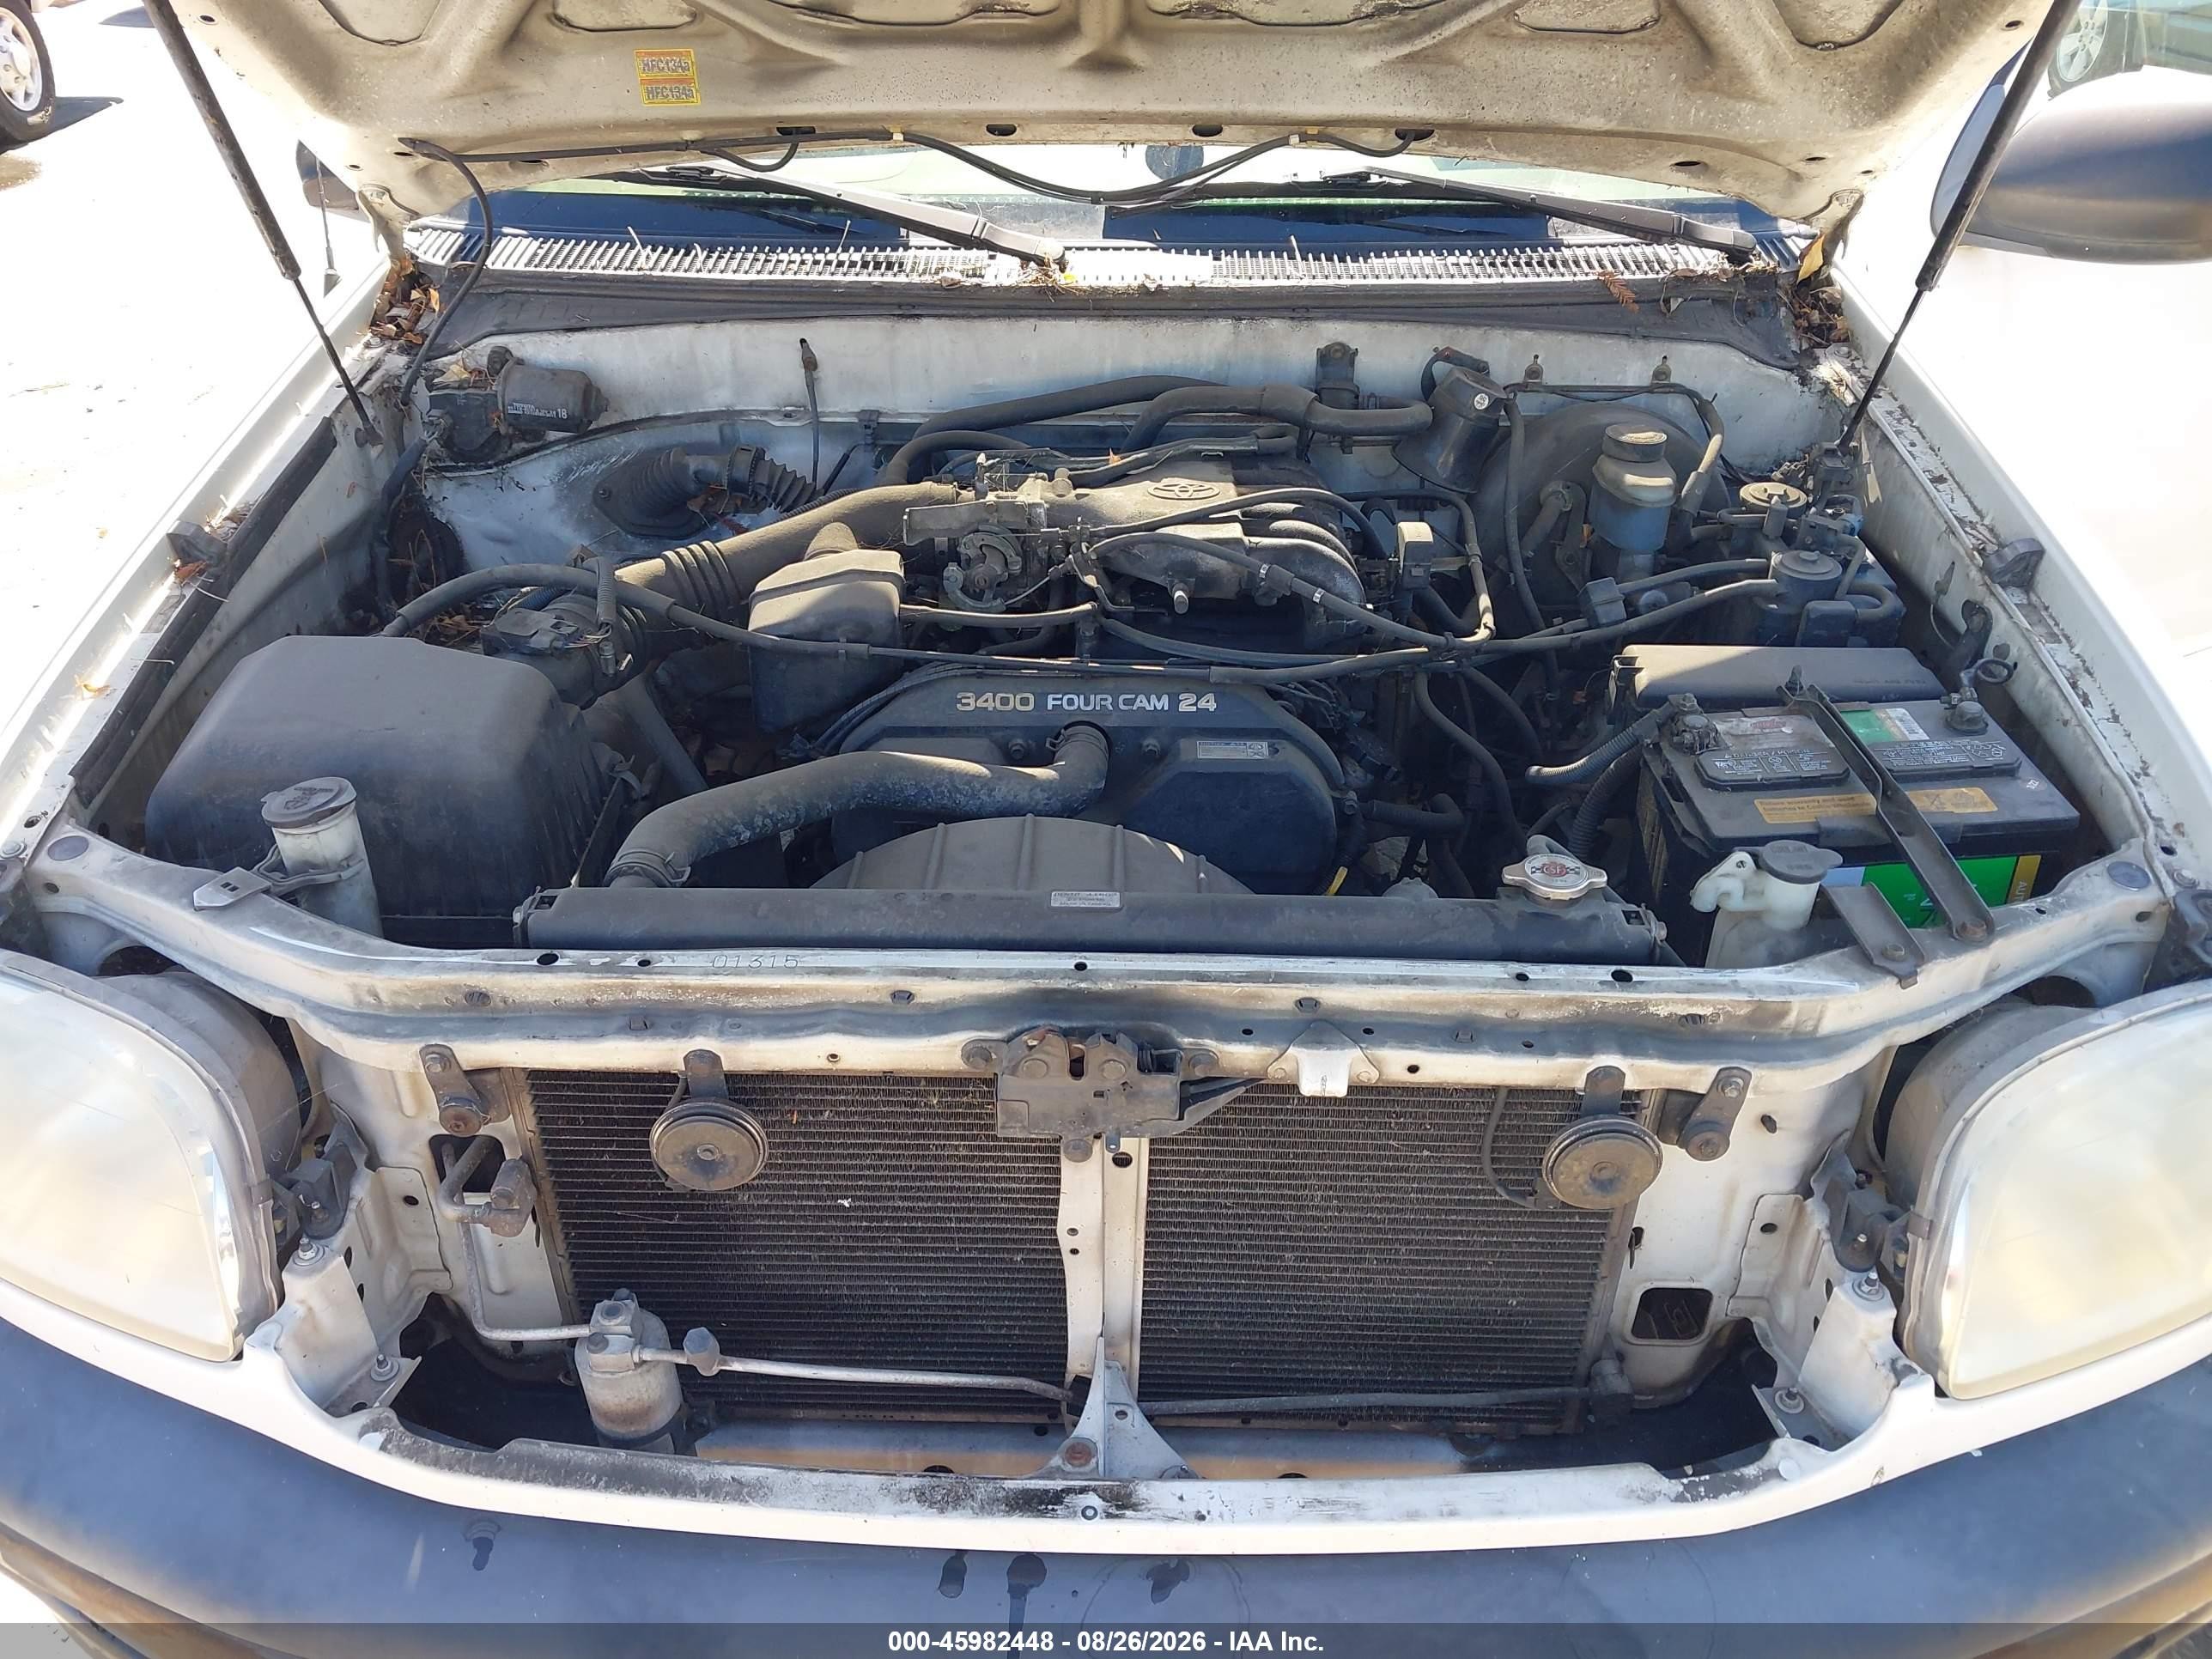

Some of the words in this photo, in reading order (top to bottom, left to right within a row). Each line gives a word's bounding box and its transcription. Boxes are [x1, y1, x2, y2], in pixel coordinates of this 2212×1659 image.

[641, 58, 690, 73] HFC134a
[645, 86, 694, 100] HFC134a
[956, 692, 1035, 712] 3400
[1047, 694, 1114, 711] FOUR
[1118, 694, 1169, 711] CAM
[1178, 692, 1217, 712] 24
[1543, 866, 1564, 874] CSF
[712, 954, 799, 969] 01315
